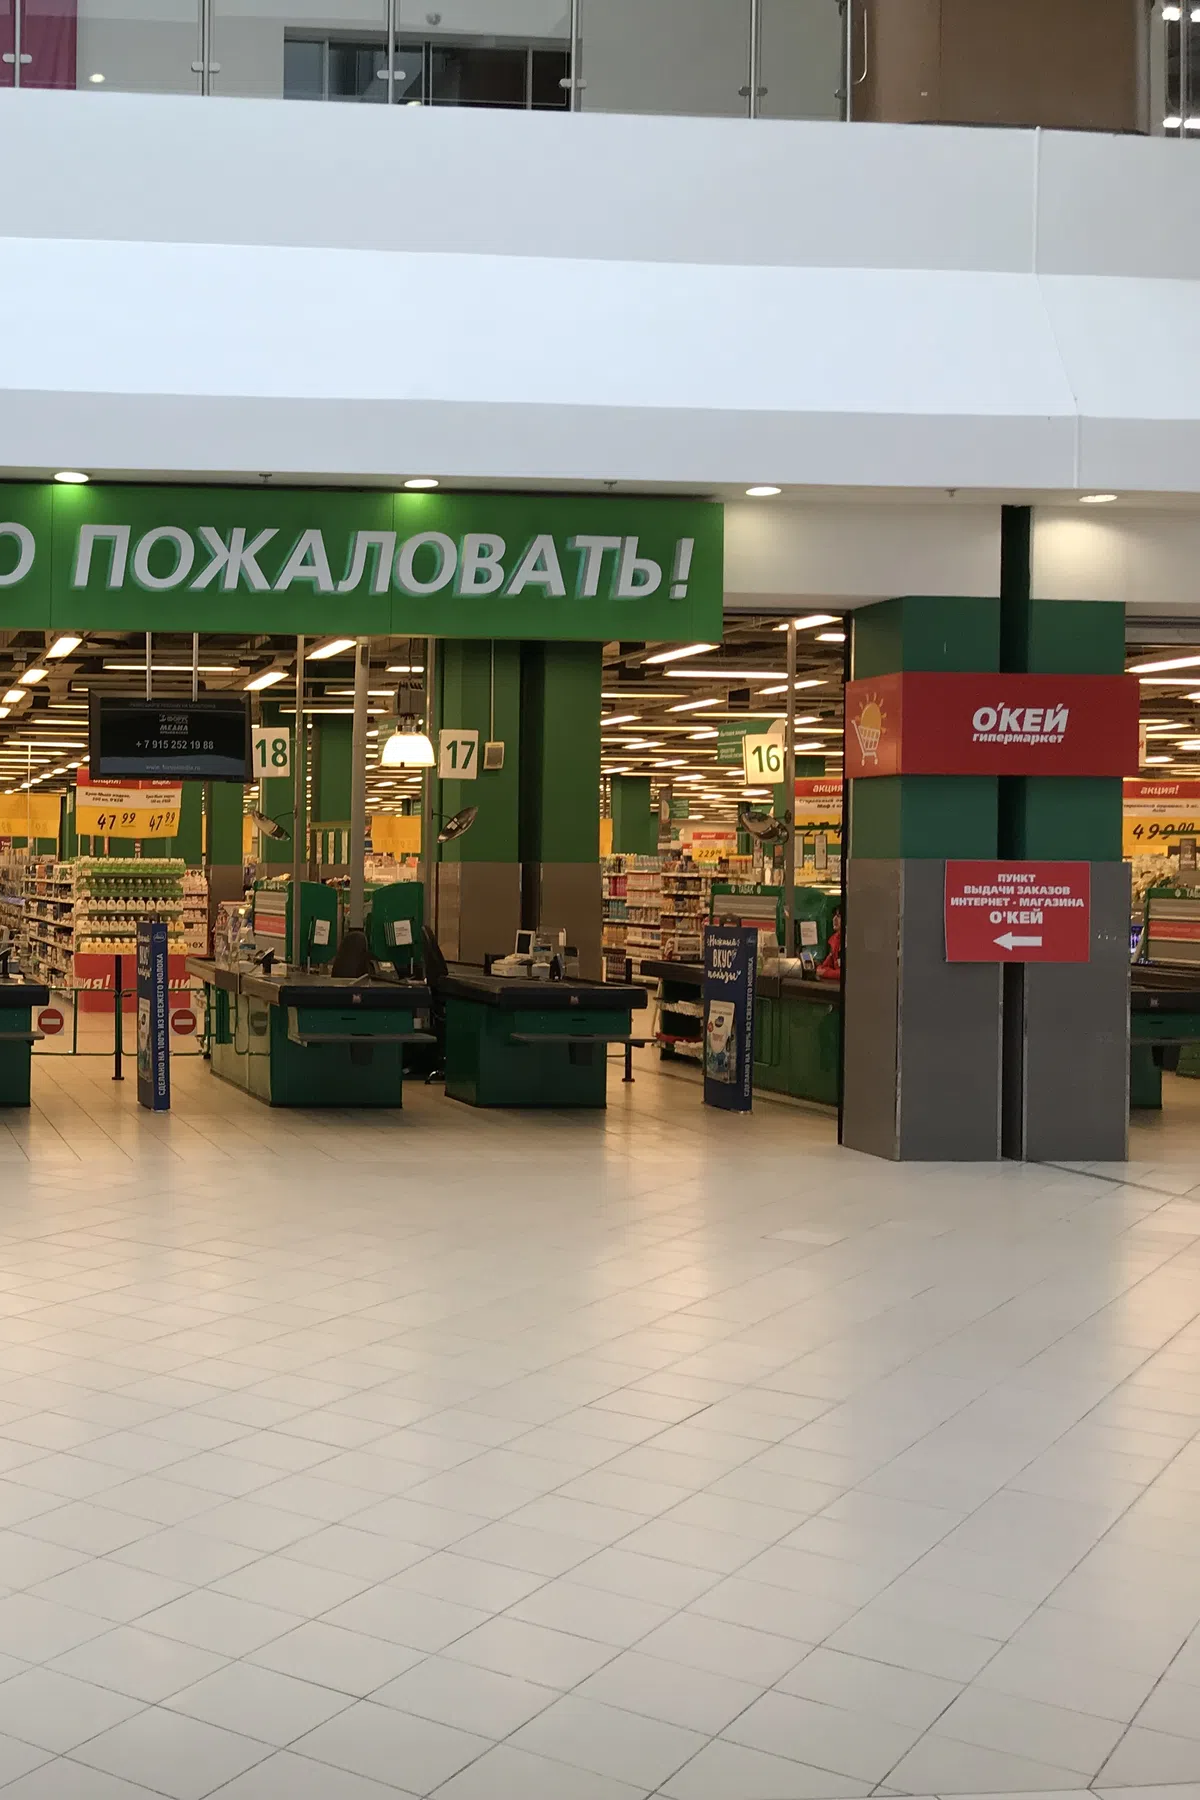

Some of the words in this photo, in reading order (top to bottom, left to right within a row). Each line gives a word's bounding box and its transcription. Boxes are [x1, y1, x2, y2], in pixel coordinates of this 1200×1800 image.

[72, 524, 696, 600] ПОЖАЛОВАТЬ!
[972, 733, 1064, 745] гипермаркет
[144, 740, 150, 749] 7
[152, 740, 169, 749] 915
[171, 740, 187, 749] 252
[190, 741, 201, 749] 19
[203, 741, 214, 750] 88
[255, 738, 288, 767] 18
[446, 740, 476, 769] 17
[751, 744, 781, 773] 16
[813, 784, 843, 793] акция
[1140, 785, 1179, 795] акция!
[98, 813, 117, 830] 47
[121, 812, 136, 824] 99
[149, 814, 163, 831] 47
[165, 811, 176, 823] 99
[698, 850, 715, 858] 229
[997, 874, 1036, 883] ПУНКТ
[738, 885, 754, 894] ТАБАК
[964, 885, 1014, 896] ВЫДАЧИ
[1017, 886, 1071, 895] ЗАКАЗОВ
[950, 897, 1010, 906] ИНТЕРНЕТ
[1019, 898, 1085, 907] МАГАЗИНА
[989, 908, 1043, 924] О'КЕЙ
[156, 953, 164, 984] МОЛОКА
[157, 1019, 164, 1029] ИЗ
[158, 1051, 165, 1061] НА
